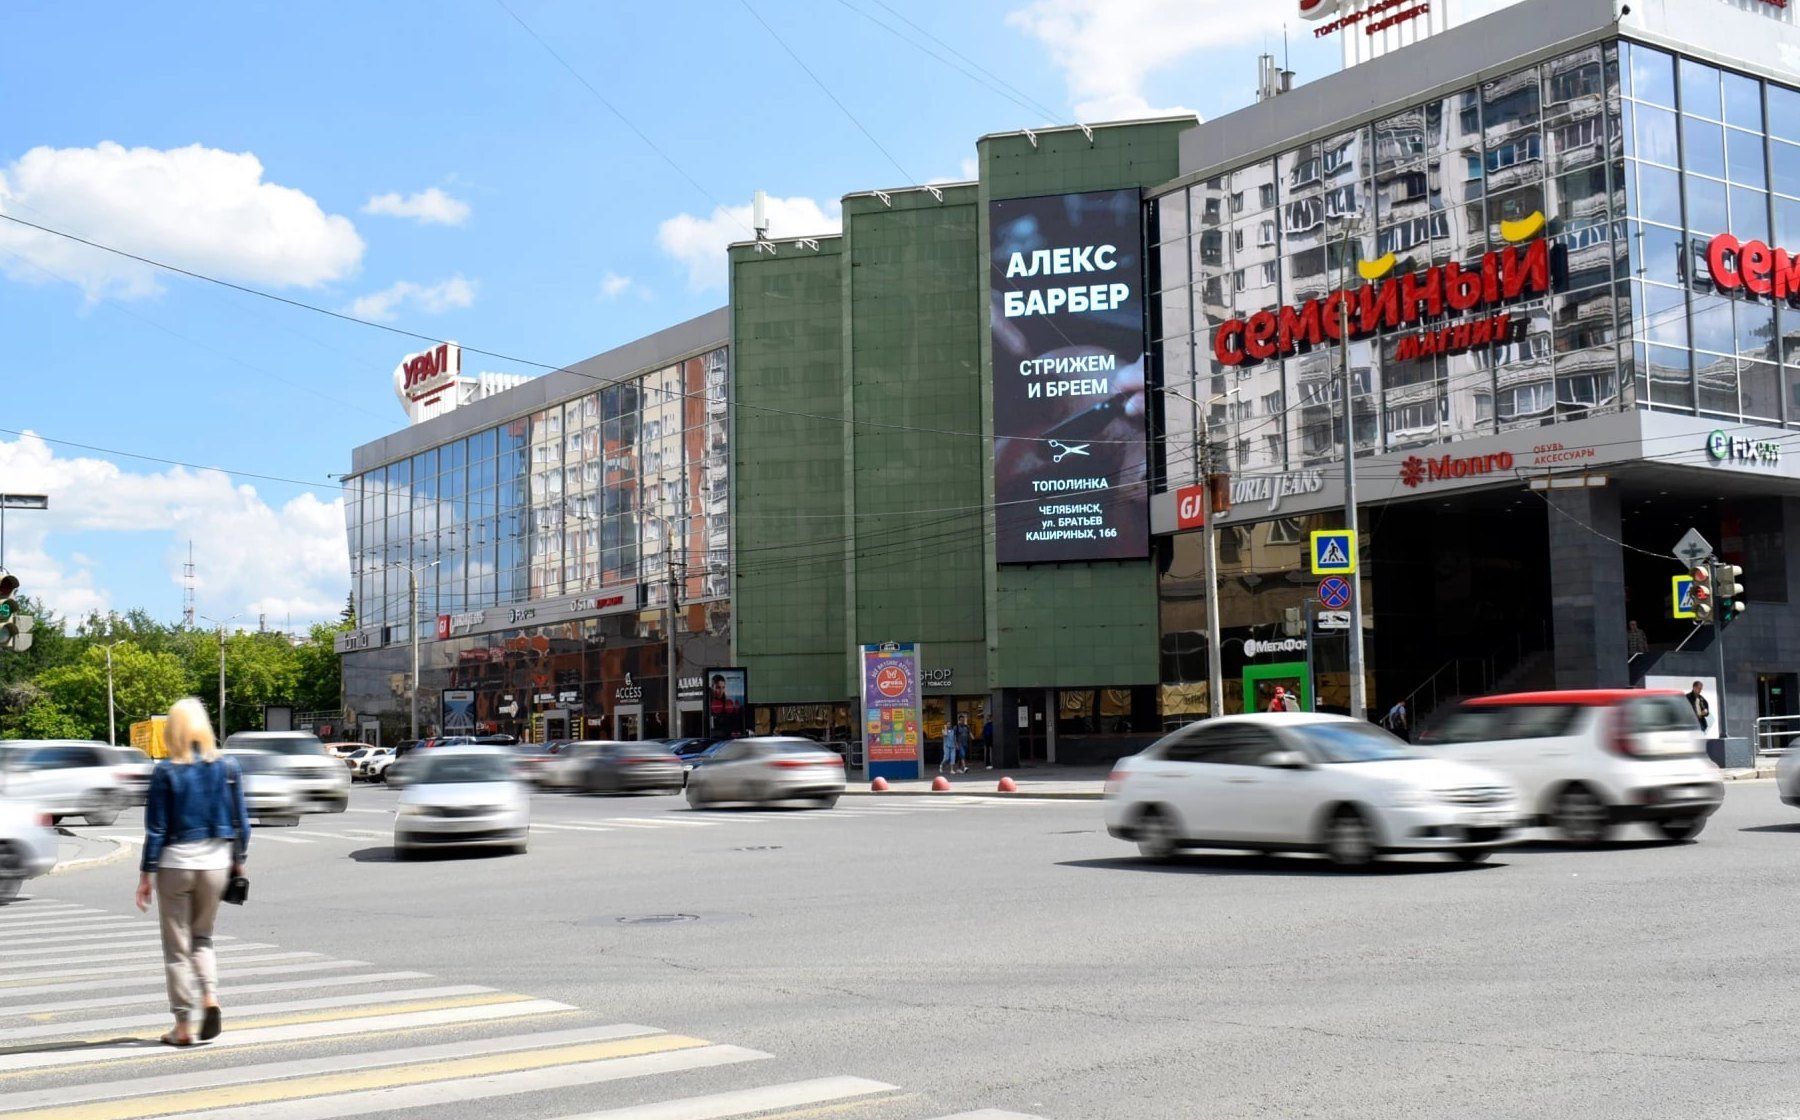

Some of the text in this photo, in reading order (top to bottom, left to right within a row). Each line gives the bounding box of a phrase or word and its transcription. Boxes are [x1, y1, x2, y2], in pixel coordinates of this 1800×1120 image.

[1006, 244, 1118, 278] АЛЕКС
[1004, 283, 1130, 318] БАРБЕР
[402, 344, 448, 389] УРАЛ
[1019, 354, 1115, 376] СТРИЖЕМ
[1028, 378, 1108, 399] И БРЕЕМ
[1533, 443, 1564, 455] ОБУВЬ
[1533, 448, 1595, 466] АКСЕССУАРЫ
[1731, 435, 1760, 460] FIX
[1427, 451, 1513, 482] Monro
[1032, 478, 1109, 492] ТОПОЛИНКА
[1214, 469, 1324, 518] LORIA JEANS
[1039, 503, 1103, 515] ЧЕЛЯБИНСК,
[1180, 494, 1201, 520] GJ
[1042, 516, 1103, 529] ул. БРАТЬЕВ
[1026, 528, 1117, 541] КАШИРИНЫХ, 166
